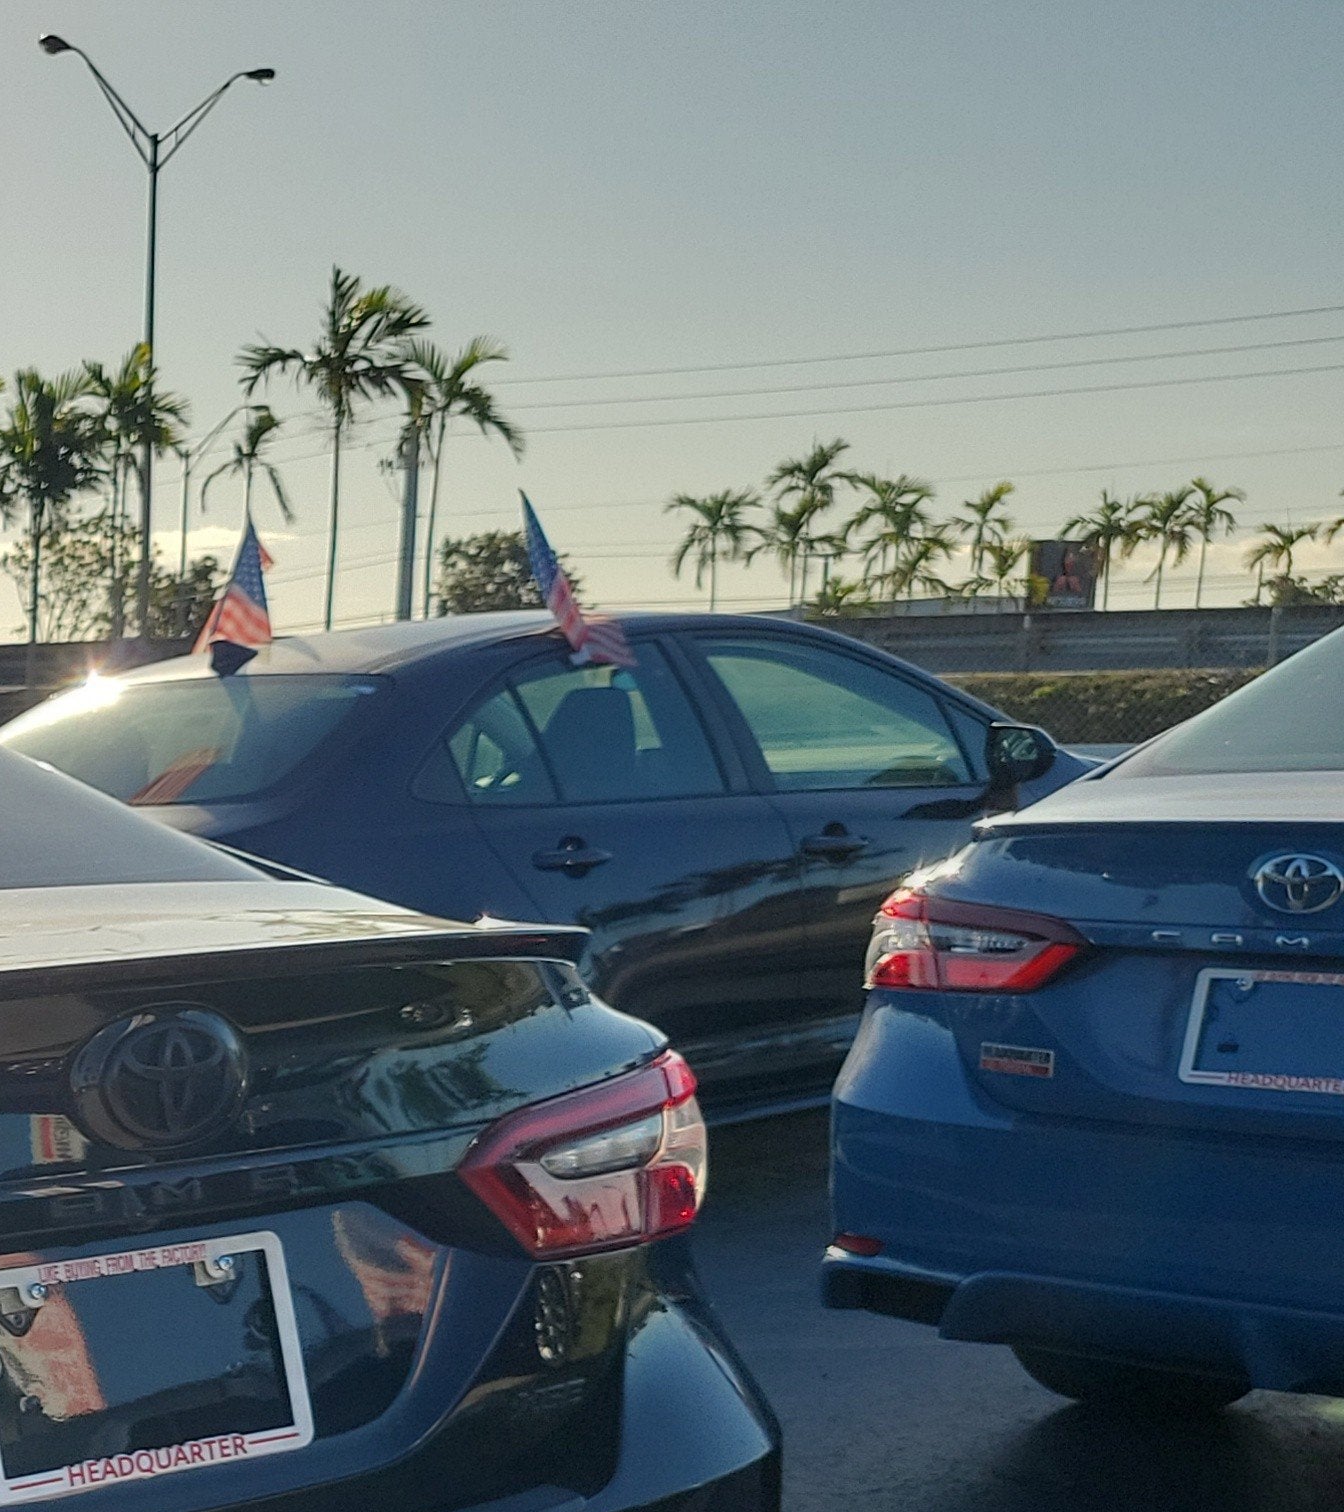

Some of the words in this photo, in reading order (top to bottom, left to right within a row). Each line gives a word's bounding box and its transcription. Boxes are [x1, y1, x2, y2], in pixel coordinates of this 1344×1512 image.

[106, 1254, 134, 1272] FROM
[139, 1250, 158, 1268] THE
[66, 1435, 248, 1488] HEADQUARTER
